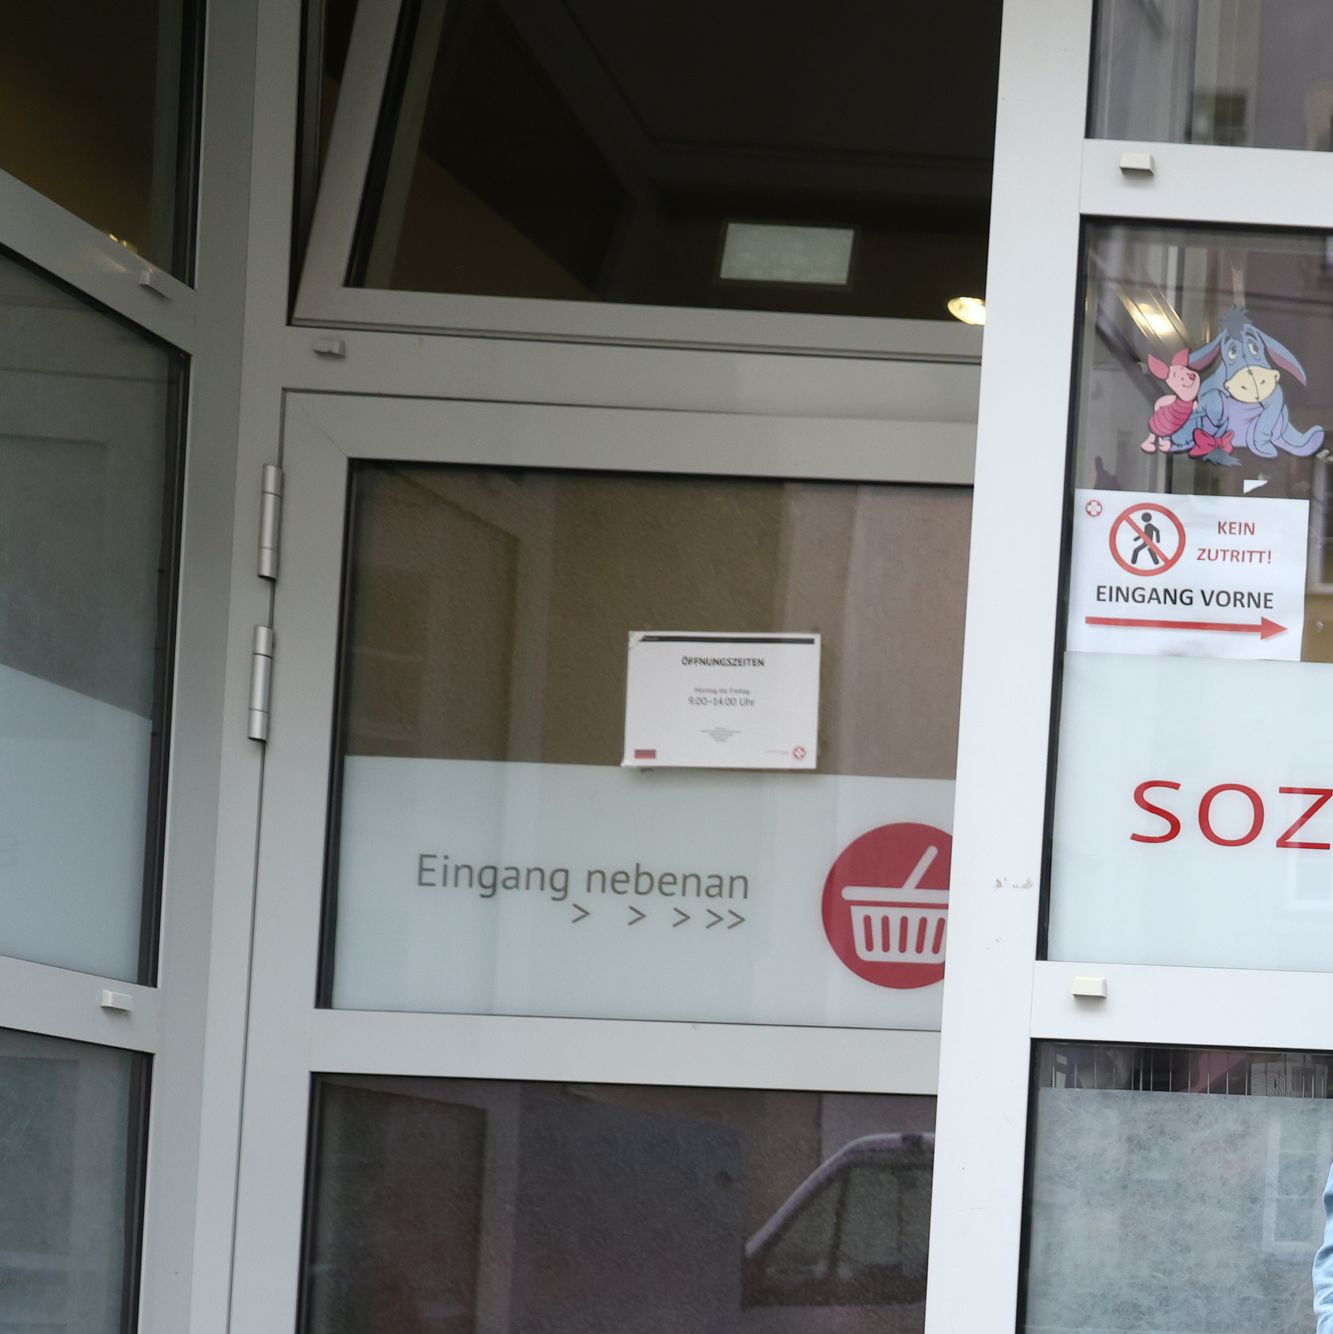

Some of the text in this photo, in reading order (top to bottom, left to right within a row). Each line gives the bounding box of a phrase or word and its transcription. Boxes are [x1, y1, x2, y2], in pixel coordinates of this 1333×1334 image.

[1217, 521, 1256, 536] KEIN
[1196, 548, 1272, 564] ZUTRITT!
[1096, 585, 1274, 609] EINGANG VORNE
[416, 853, 749, 901] Eingang nebenan
